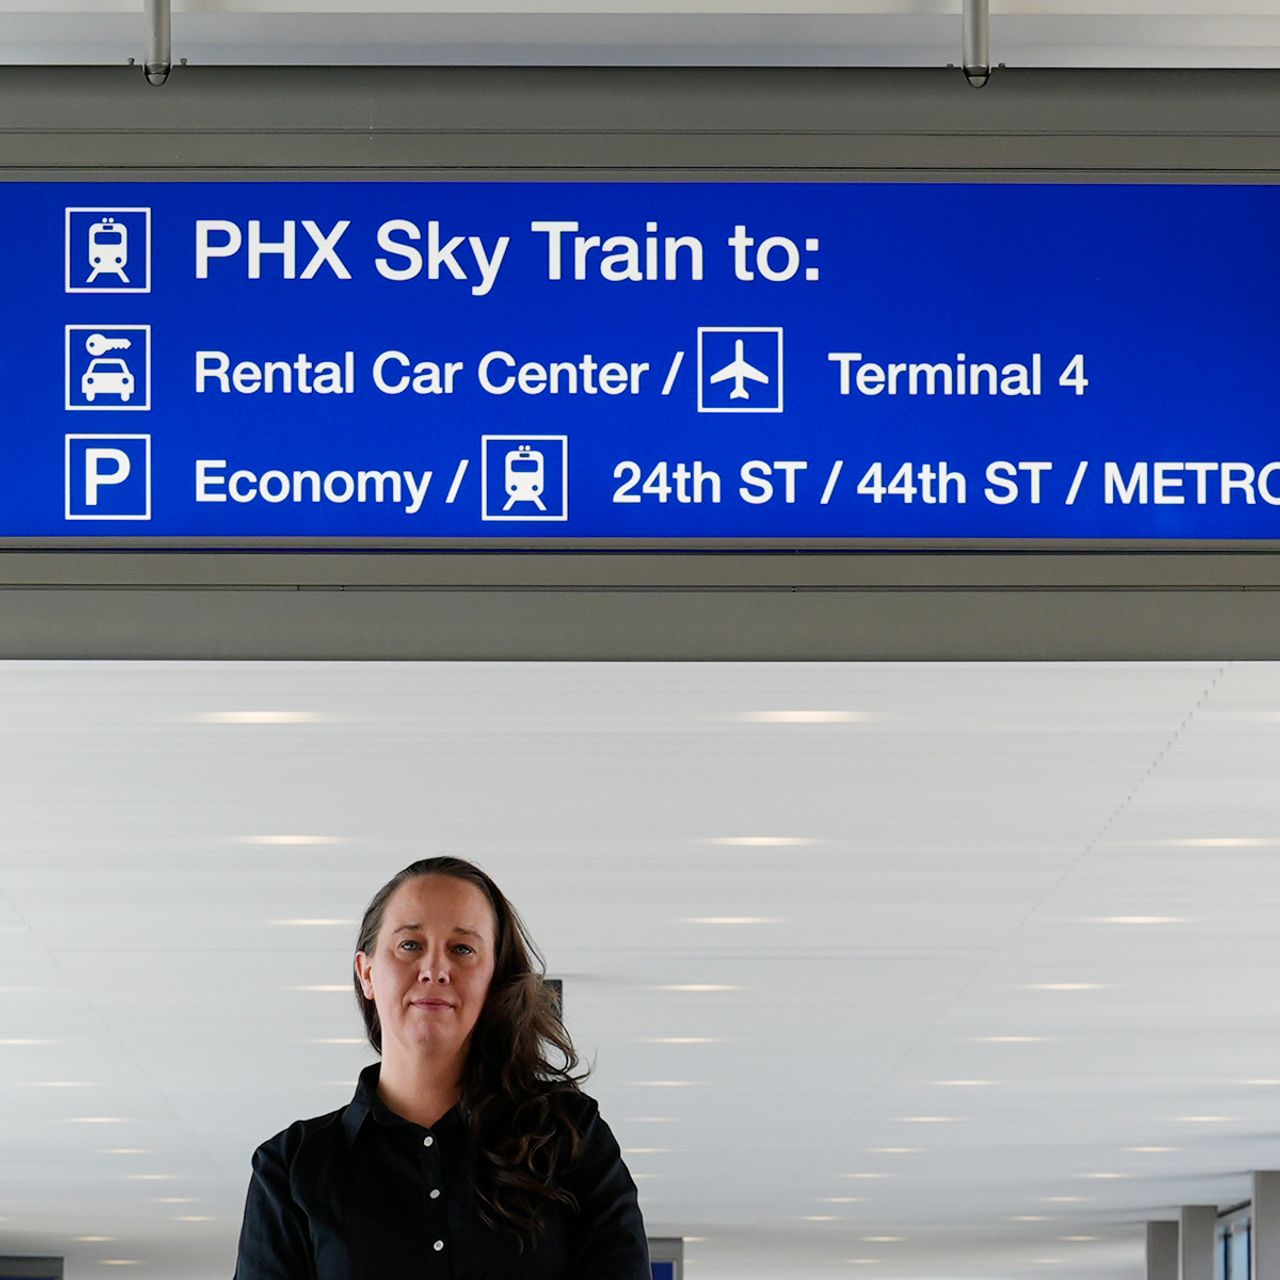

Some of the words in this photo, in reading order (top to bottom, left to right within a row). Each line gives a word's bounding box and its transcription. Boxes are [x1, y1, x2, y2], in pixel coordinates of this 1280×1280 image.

[195, 220, 351, 280] PHX
[375, 219, 510, 296] Sky
[530, 221, 703, 282] Train
[727, 225, 819, 282] to:
[195, 350, 354, 394] Rental
[372, 350, 464, 395] Car
[477, 350, 650, 395] Center
[662, 351, 685, 396] /
[827, 352, 1041, 396] Terminal
[1058, 354, 1089, 396] 4
[84, 448, 132, 505] P
[195, 459, 433, 514] Economy
[446, 460, 469, 504] /
[612, 460, 721, 505] 24th
[739, 459, 808, 505] ST
[820, 460, 844, 505] /
[856, 460, 967, 505] 44th
[984, 459, 1053, 505] ST
[1065, 460, 1089, 505] /
